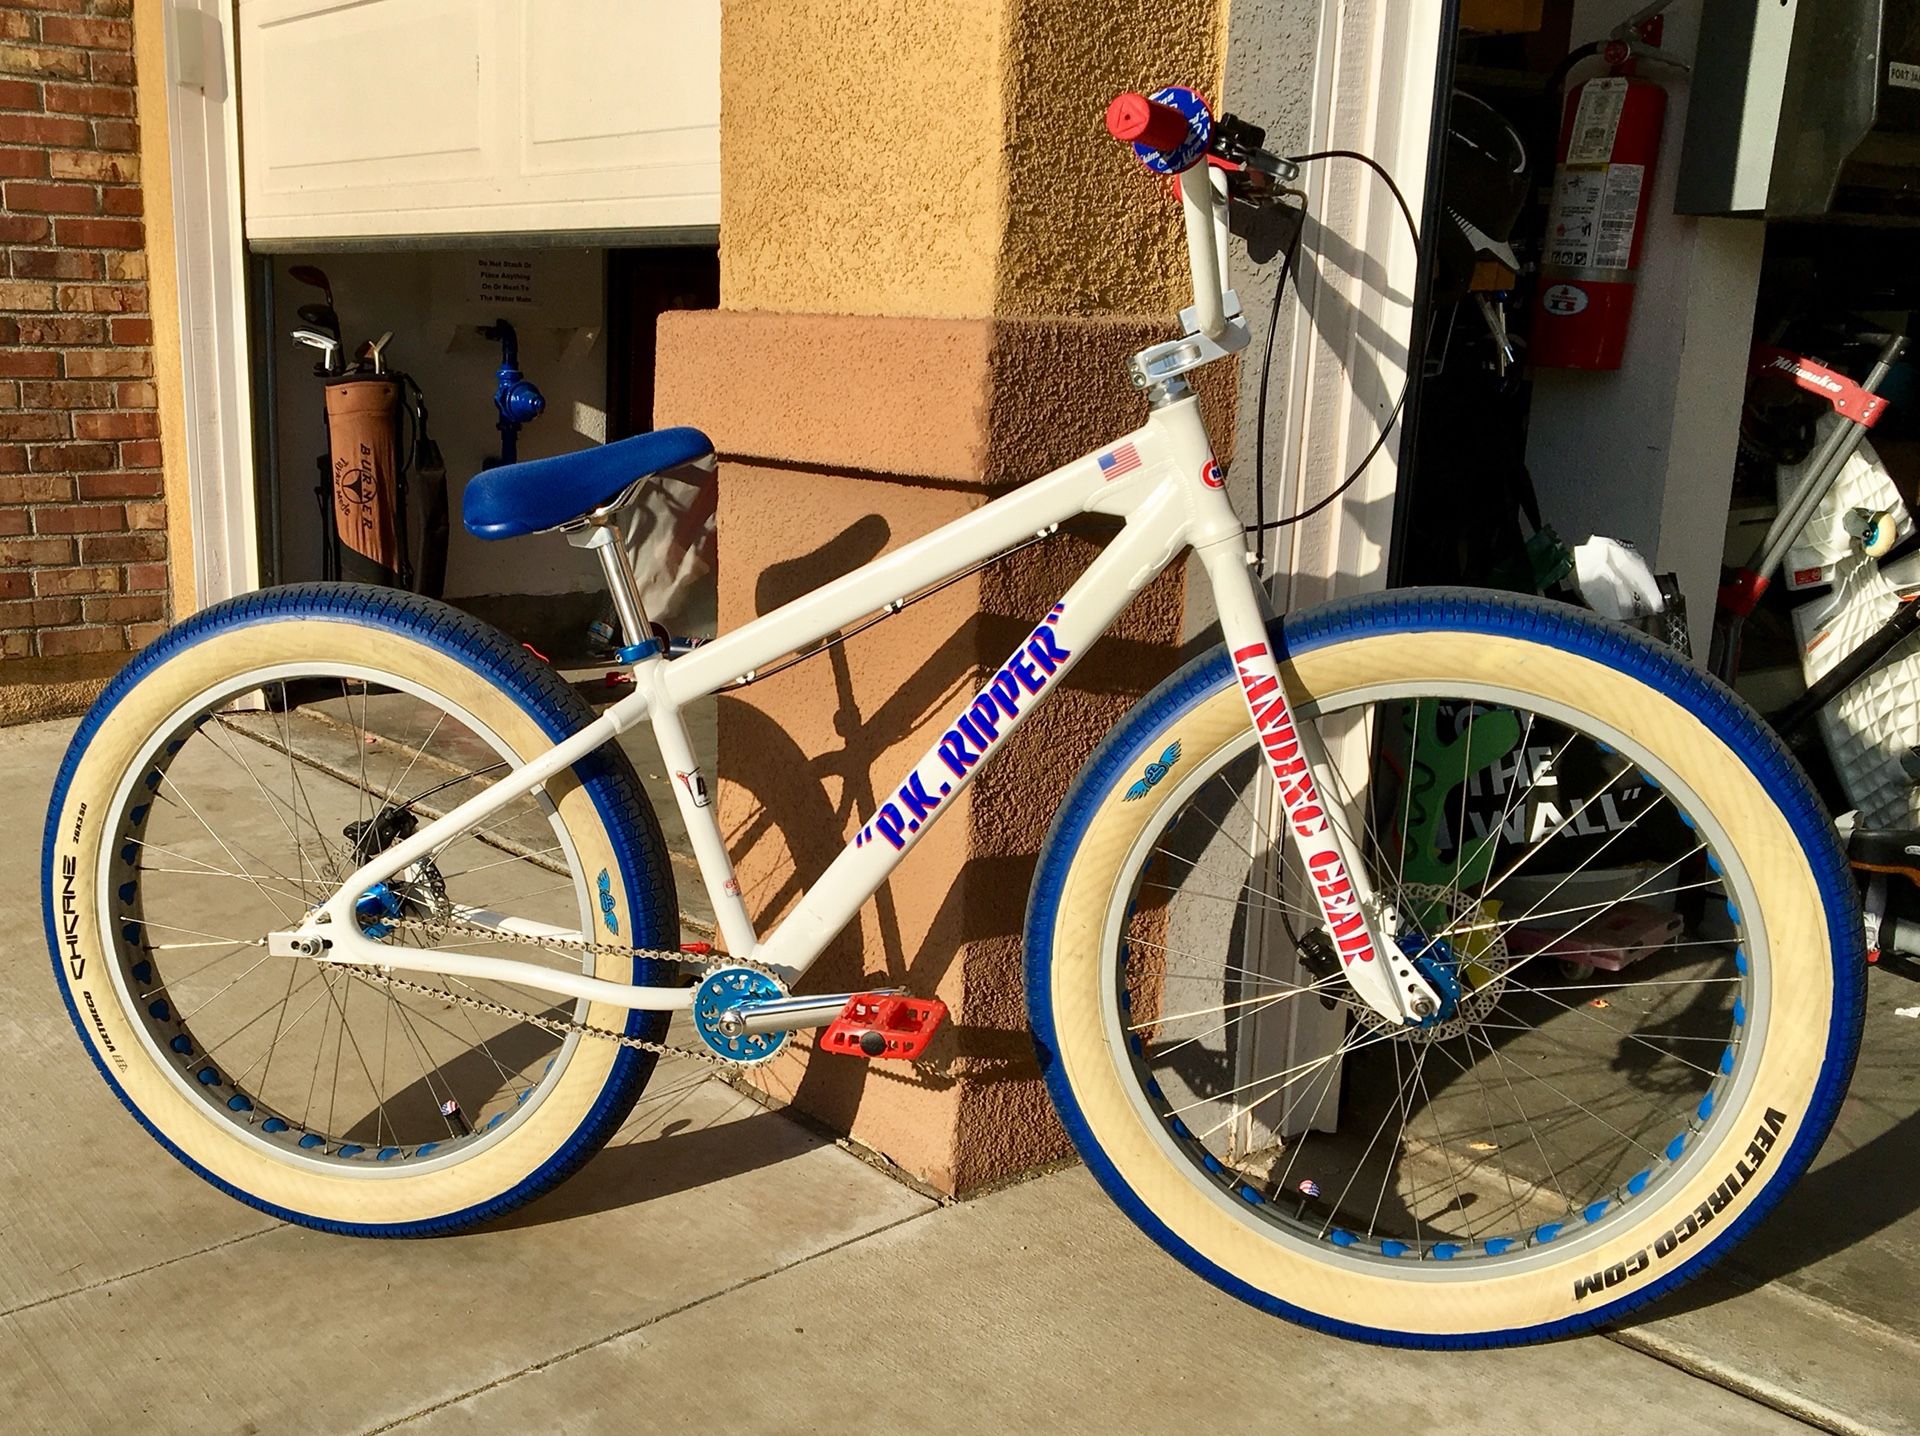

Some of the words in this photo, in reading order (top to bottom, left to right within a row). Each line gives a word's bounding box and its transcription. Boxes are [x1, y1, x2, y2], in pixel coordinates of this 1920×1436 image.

[501, 272, 531, 281] Anything
[520, 284, 530, 292] To
[360, 443, 373, 530] BURNER
[62, 855, 86, 980] CHICANE
[1309, 850, 1375, 967] GEAR
[1573, 1107, 1788, 1302] VEETIRECO.COM
